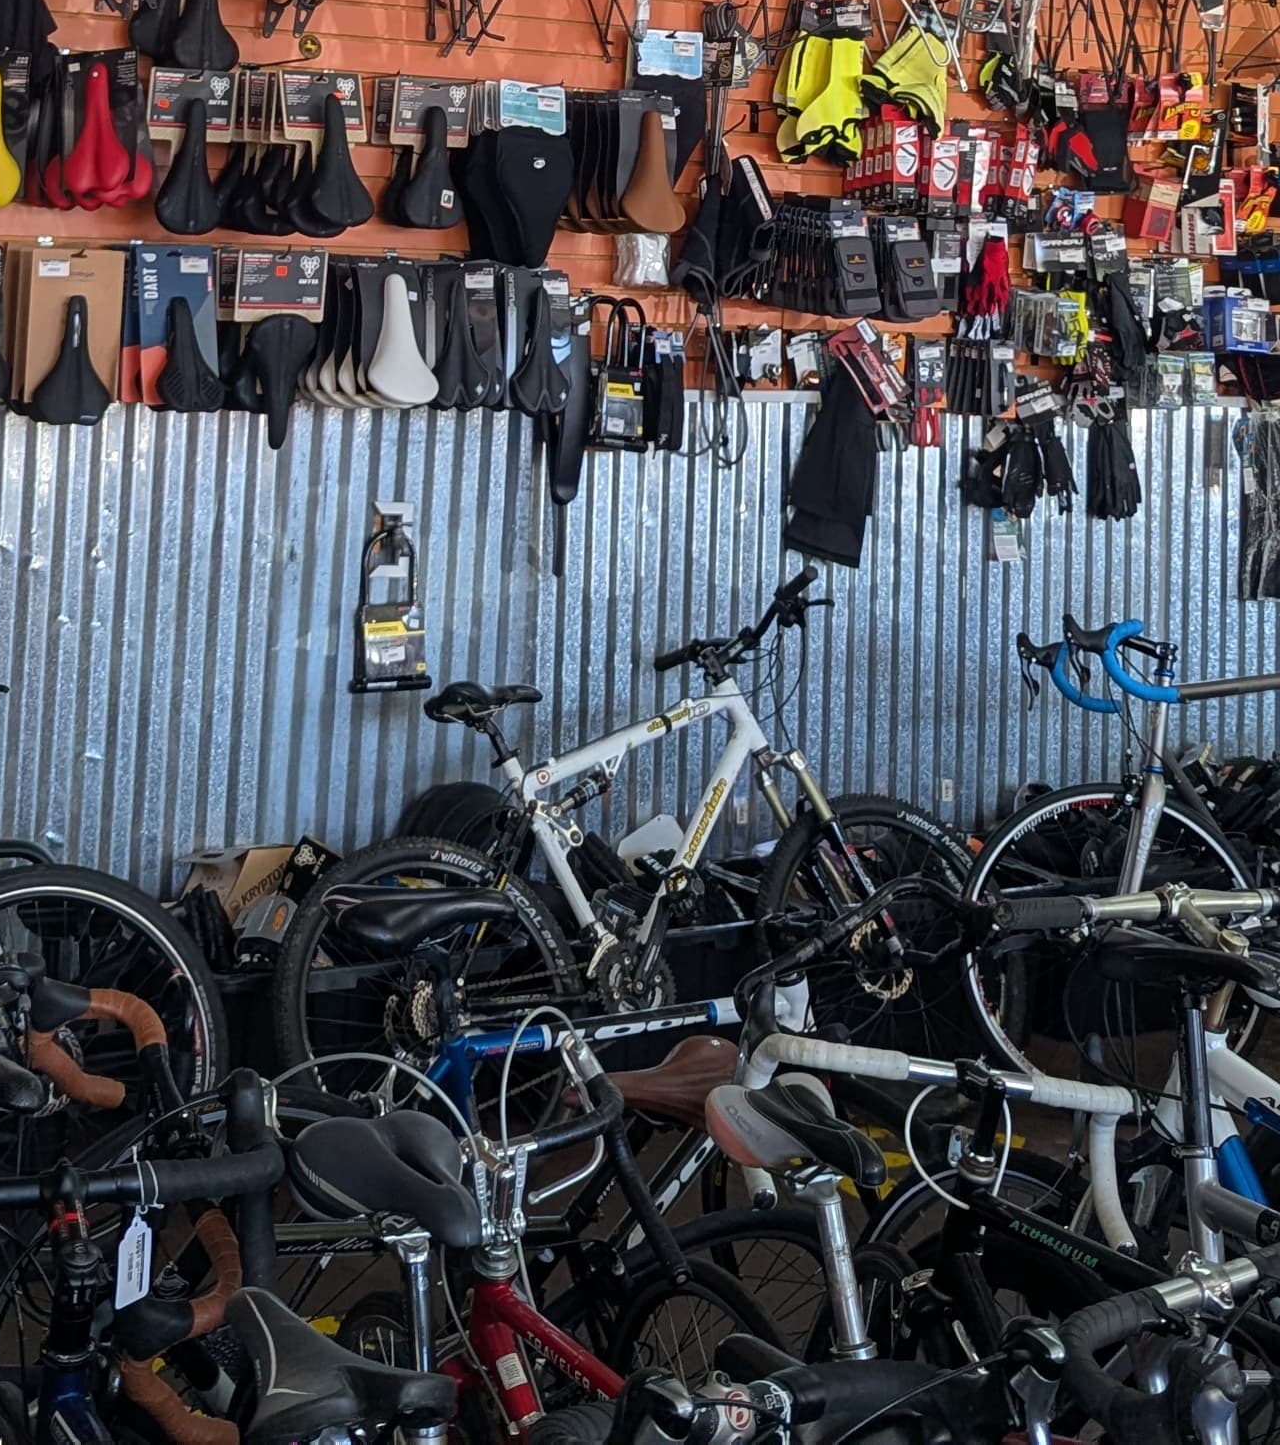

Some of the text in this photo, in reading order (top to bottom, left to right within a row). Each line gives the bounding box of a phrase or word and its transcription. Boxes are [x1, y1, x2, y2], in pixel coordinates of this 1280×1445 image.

[1040, 238, 1084, 247] GARNEAU
[143, 268, 159, 300] DART
[684, 777, 727, 865] Mountain
[905, 812, 941, 837] vittoria
[1013, 802, 1071, 843] american
[440, 851, 484, 875] vittoria
[557, 1014, 710, 1043] LOOK
[1009, 1220, 1100, 1269] ALUMINUM
[526, 1330, 590, 1391] TRAVELER
